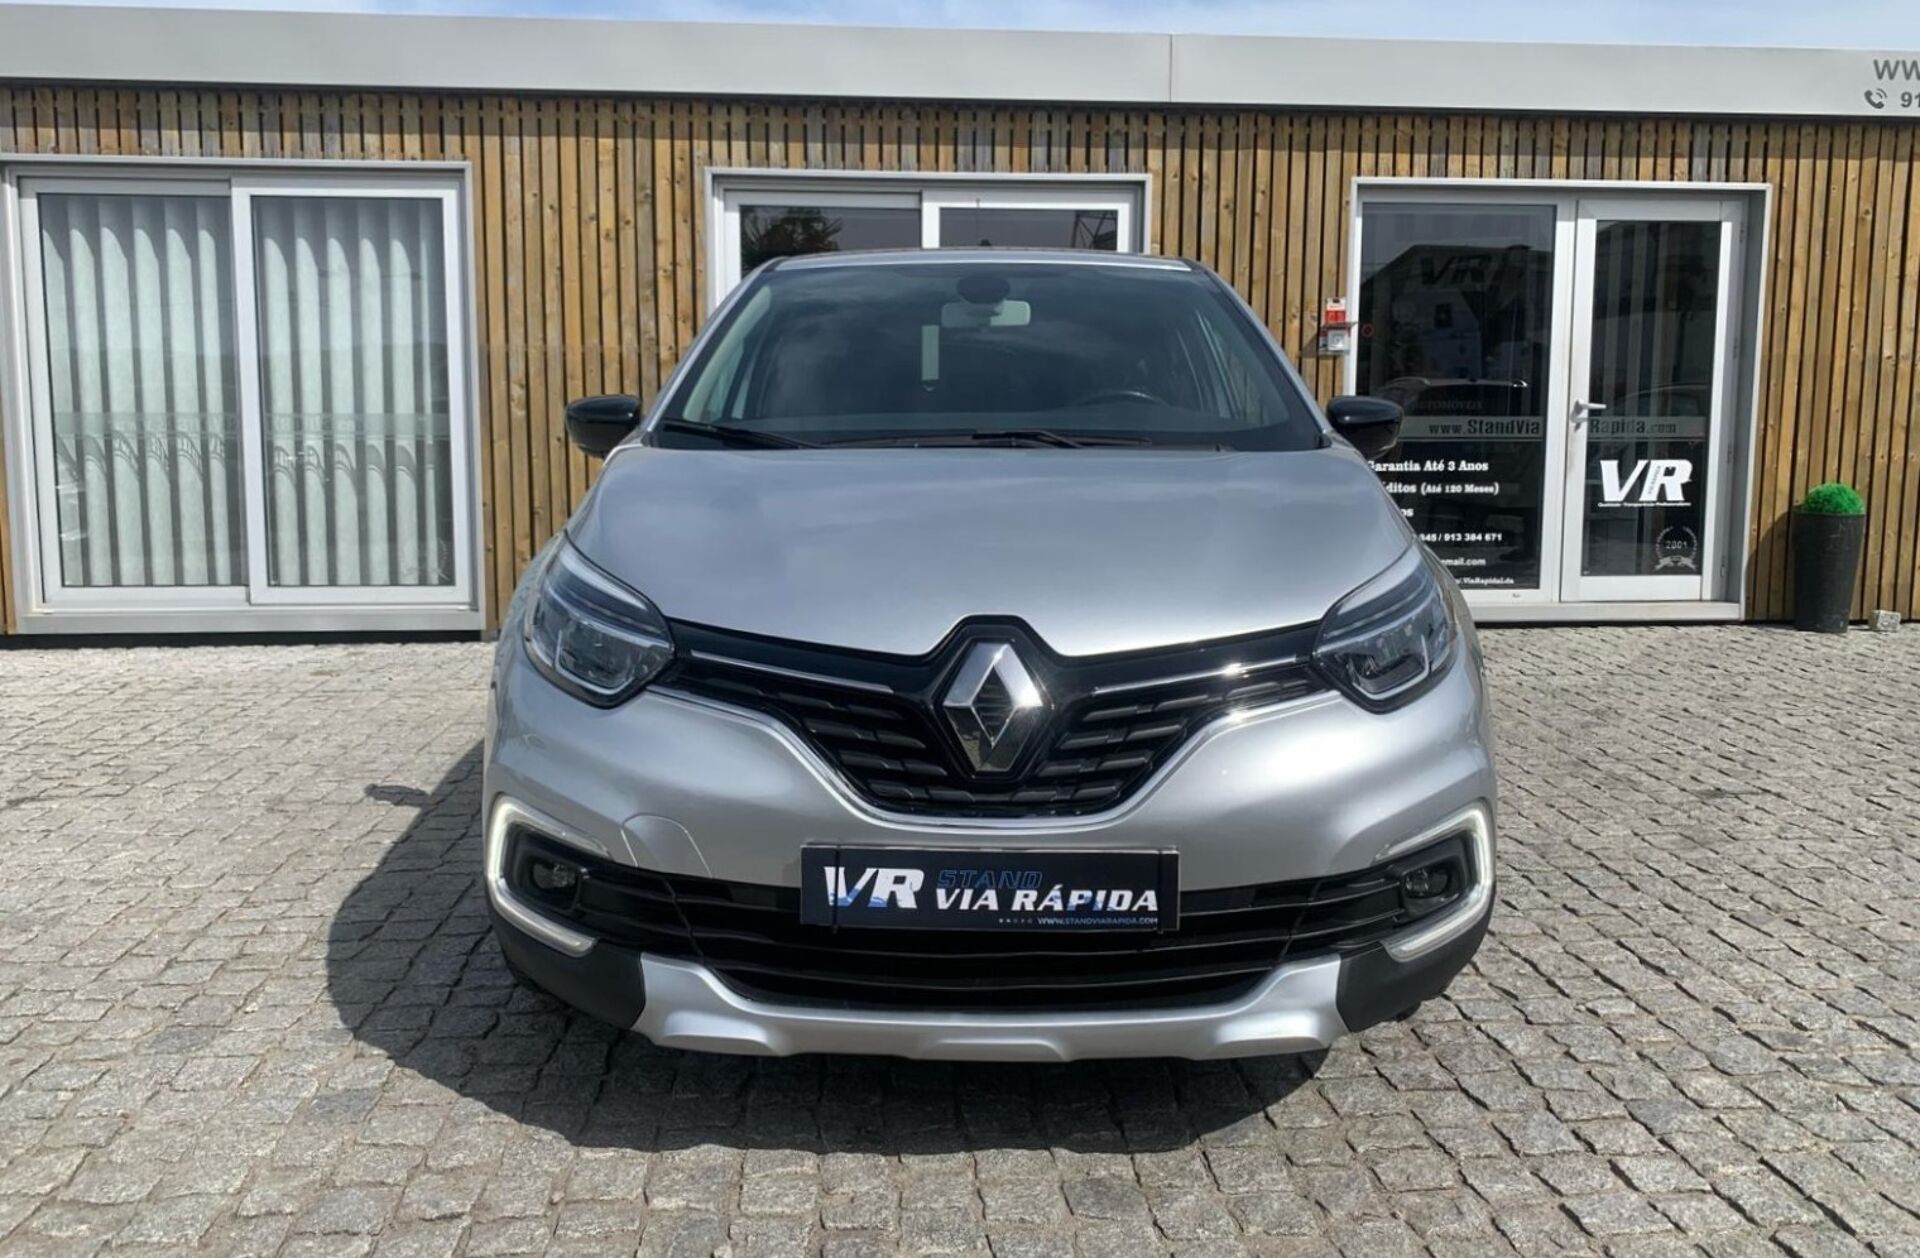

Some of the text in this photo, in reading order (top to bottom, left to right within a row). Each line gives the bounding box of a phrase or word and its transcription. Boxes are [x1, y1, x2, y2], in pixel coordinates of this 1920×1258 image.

[1423, 459, 1445, 472] Até
[1447, 461, 1456, 472] 3
[1458, 461, 1489, 472] Anos
[1444, 485, 1462, 493] 120
[1600, 459, 1693, 502] VR
[823, 866, 925, 910] VR
[937, 869, 1043, 889] STAND
[935, 884, 1159, 912] VIA RÁPIDA
